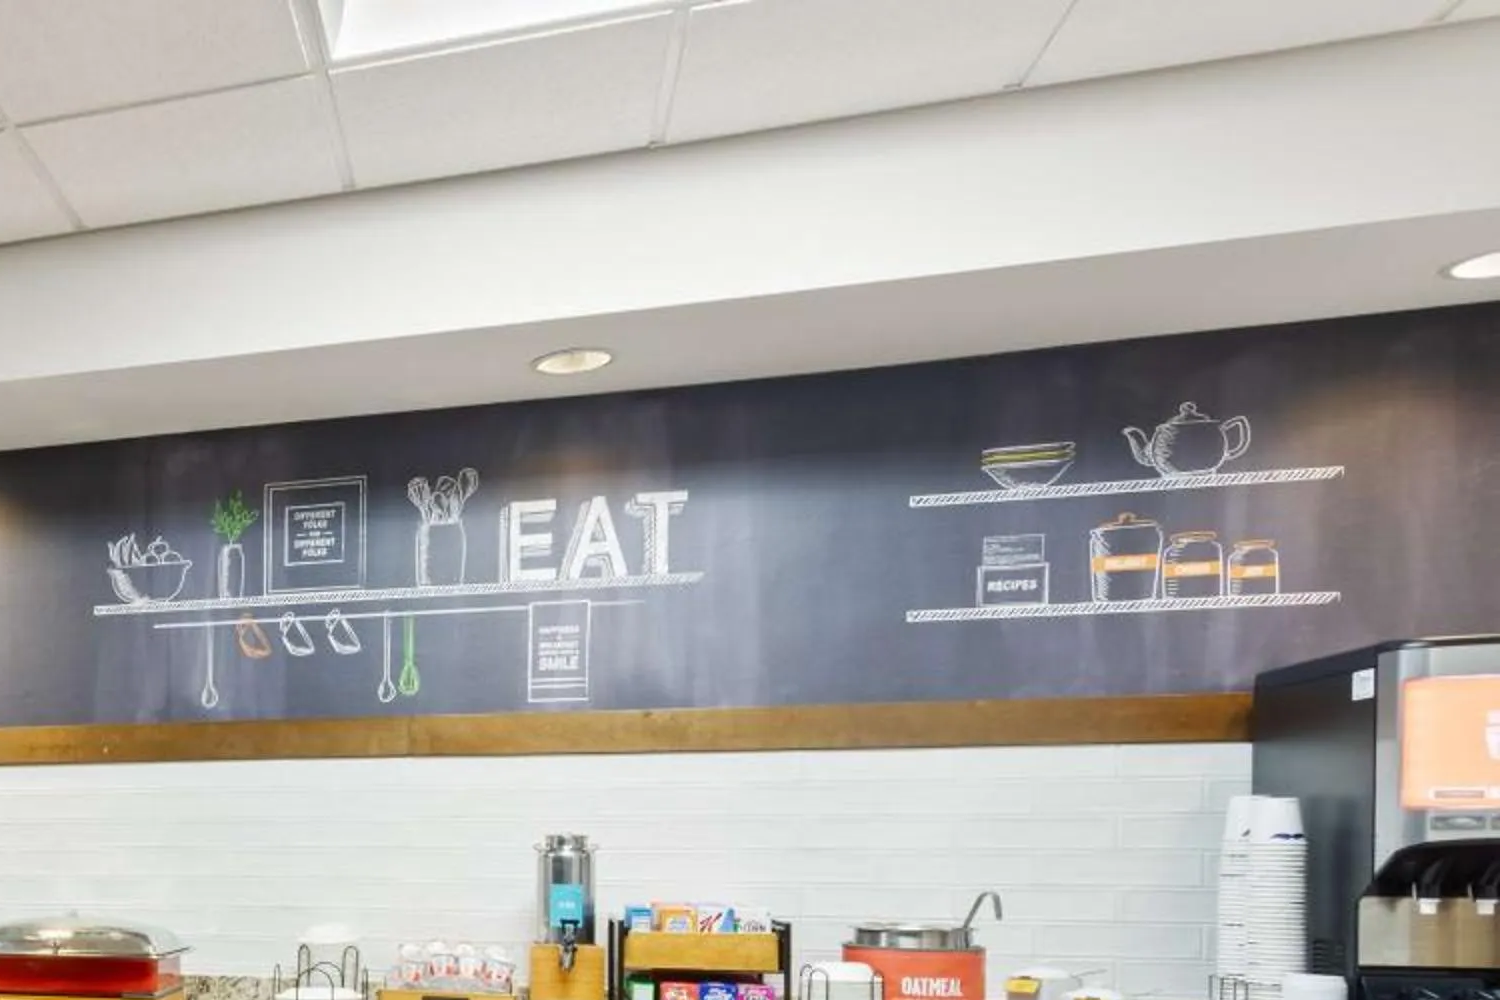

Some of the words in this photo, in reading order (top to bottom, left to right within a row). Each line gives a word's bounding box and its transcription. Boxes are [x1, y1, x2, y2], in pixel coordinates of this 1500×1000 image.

[502, 489, 688, 581] EAT
[987, 578, 1038, 593] RECIPES
[901, 976, 964, 997] OATMEAL
